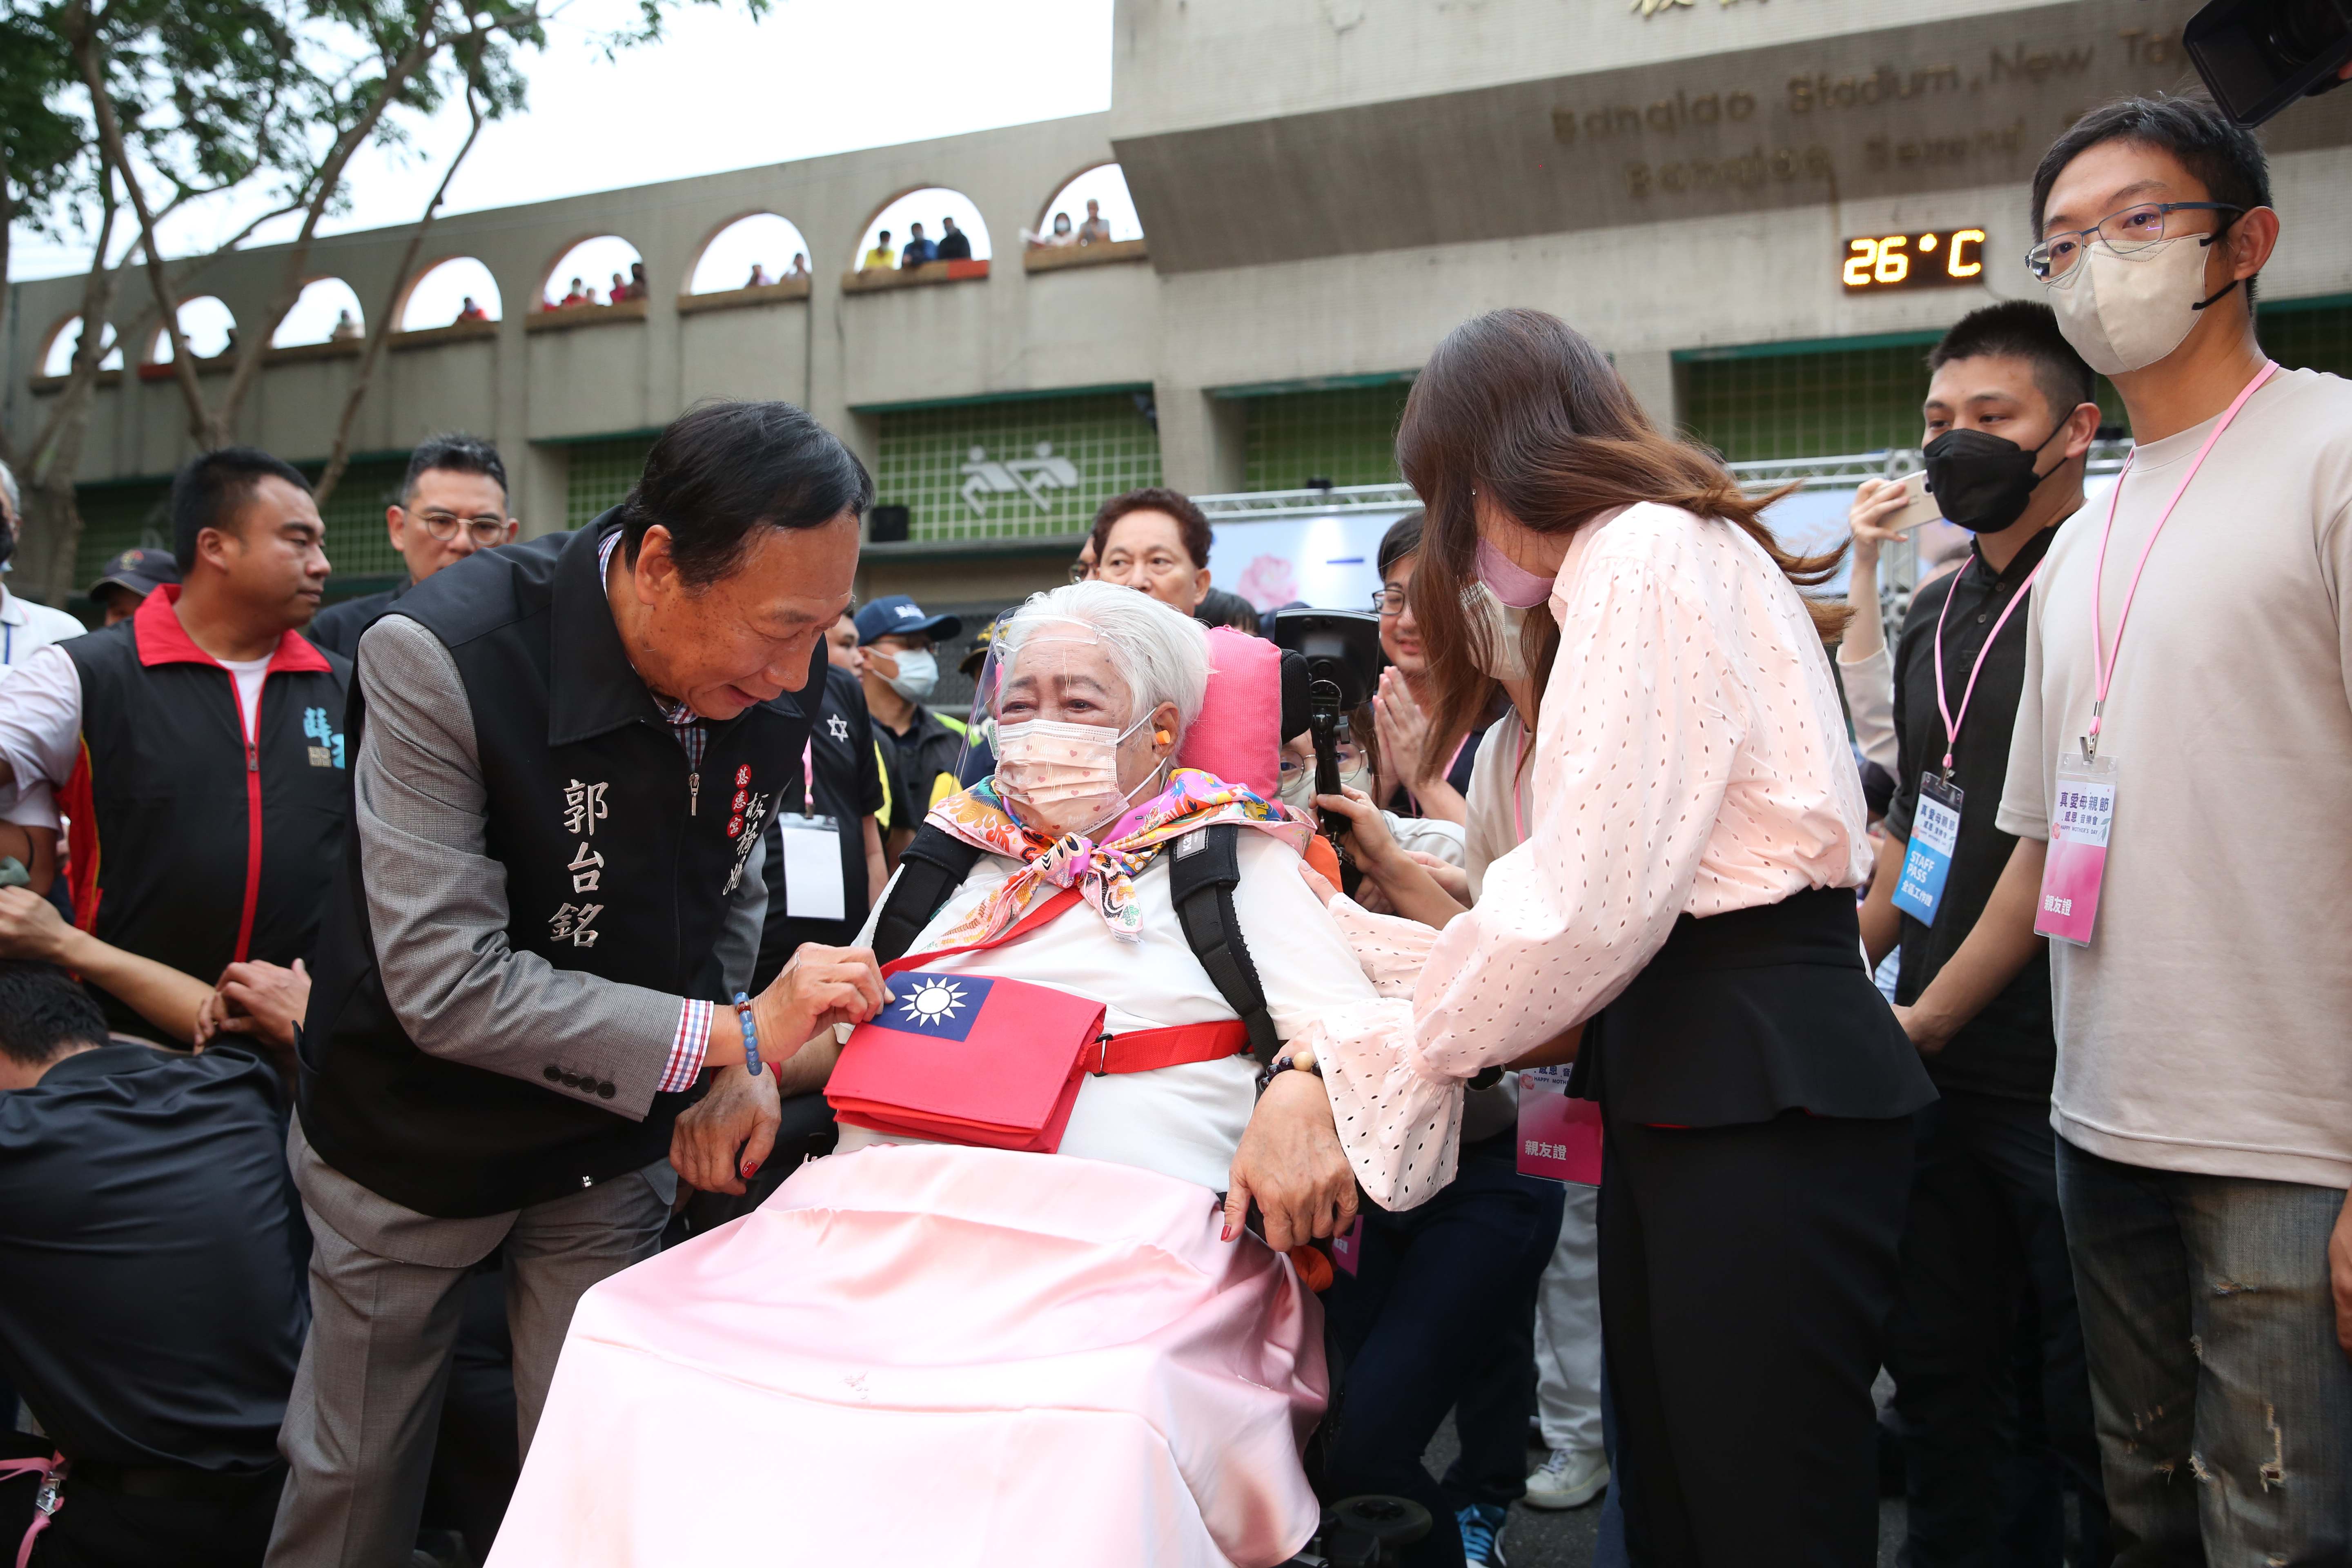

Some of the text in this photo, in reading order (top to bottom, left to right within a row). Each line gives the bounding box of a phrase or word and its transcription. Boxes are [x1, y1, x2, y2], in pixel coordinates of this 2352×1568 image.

[1989, 40, 2096, 82] New
[2060, 791, 2109, 812] 真愛母親節
[2064, 811, 2098, 825] 感恩 音樂會
[548, 779, 609, 948] 郭台銘
[1910, 850, 1935, 872] STAFF
[1906, 862, 1928, 883] PASS
[2044, 894, 2072, 916] 親友證
[1525, 1140, 1567, 1160] 親友證
